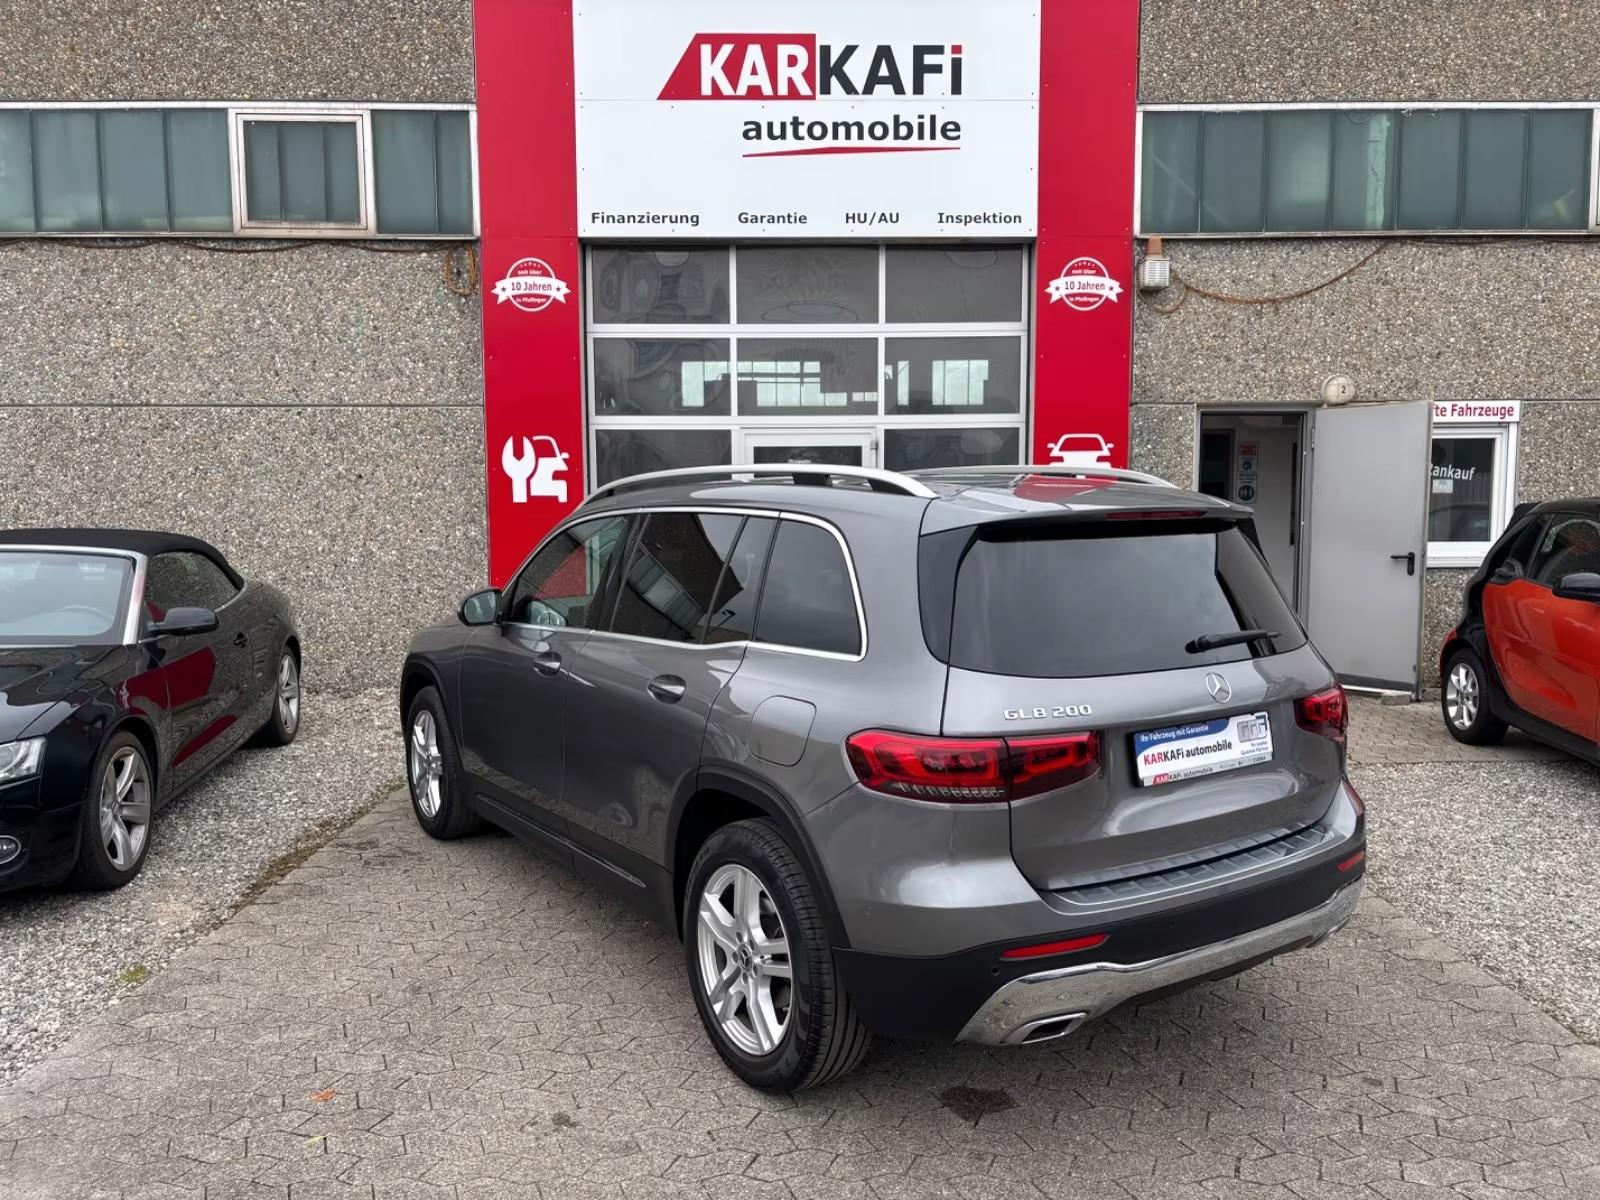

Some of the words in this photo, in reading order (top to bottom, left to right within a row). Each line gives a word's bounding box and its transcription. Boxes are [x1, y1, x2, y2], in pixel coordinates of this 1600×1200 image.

[700, 44, 963, 96] KARKAFi
[742, 114, 961, 141] automobile
[591, 211, 700, 226] Finanzierung
[737, 211, 808, 224] Garantie
[845, 211, 900, 225] HU/AU
[937, 211, 1022, 227] Inspektion
[511, 281, 522, 291] 10
[523, 281, 552, 291] Jahren
[1065, 281, 1075, 290] 10
[1077, 281, 1106, 290] Jahren
[1341, 384, 1347, 394] 2
[1433, 403, 1447, 417] te
[1451, 403, 1515, 420] Fahrzeuge
[1004, 707, 1047, 720] GLB
[1052, 704, 1093, 718] 200
[1149, 730, 1176, 740] Fahrzeug
[1176, 727, 1186, 736] mit
[1144, 747, 1184, 766] KARKAFi
[1185, 739, 1233, 758] automobile
